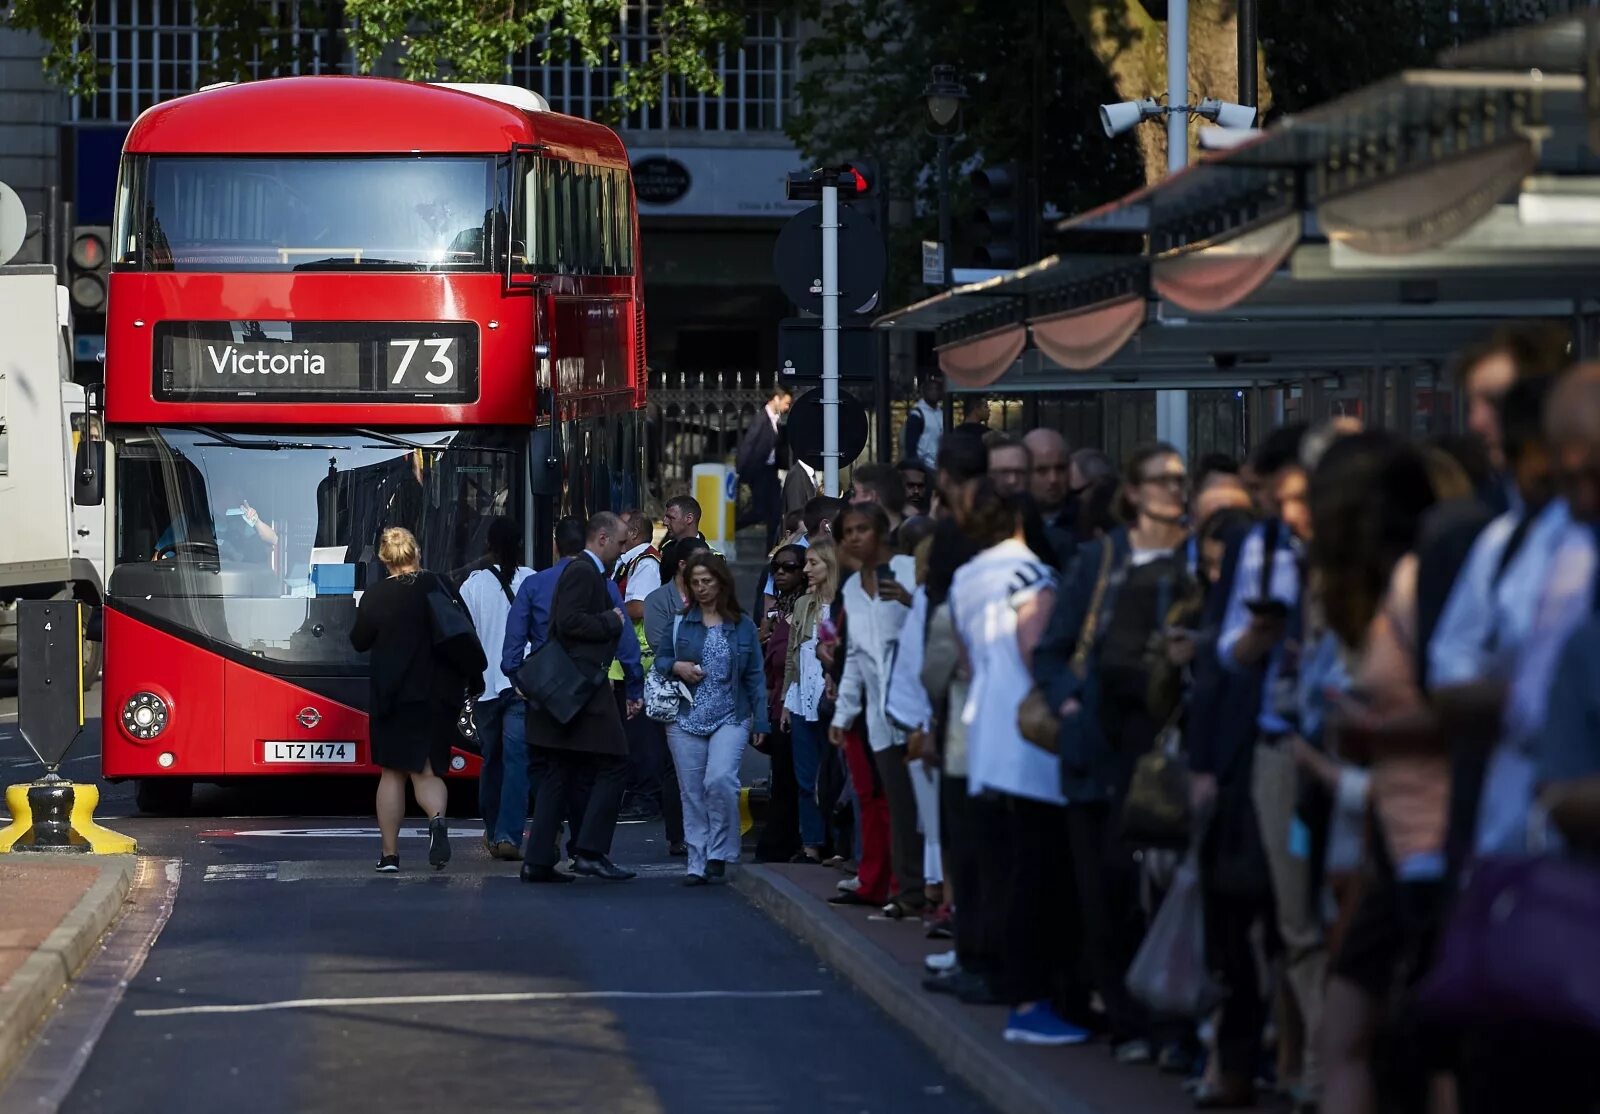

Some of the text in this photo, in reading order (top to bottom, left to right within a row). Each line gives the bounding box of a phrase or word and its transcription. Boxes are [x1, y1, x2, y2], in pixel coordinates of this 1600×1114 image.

[207, 338, 454, 385] Victoria 73
[44, 622, 52, 631] 4
[275, 744, 346, 759] LTZ 1474
